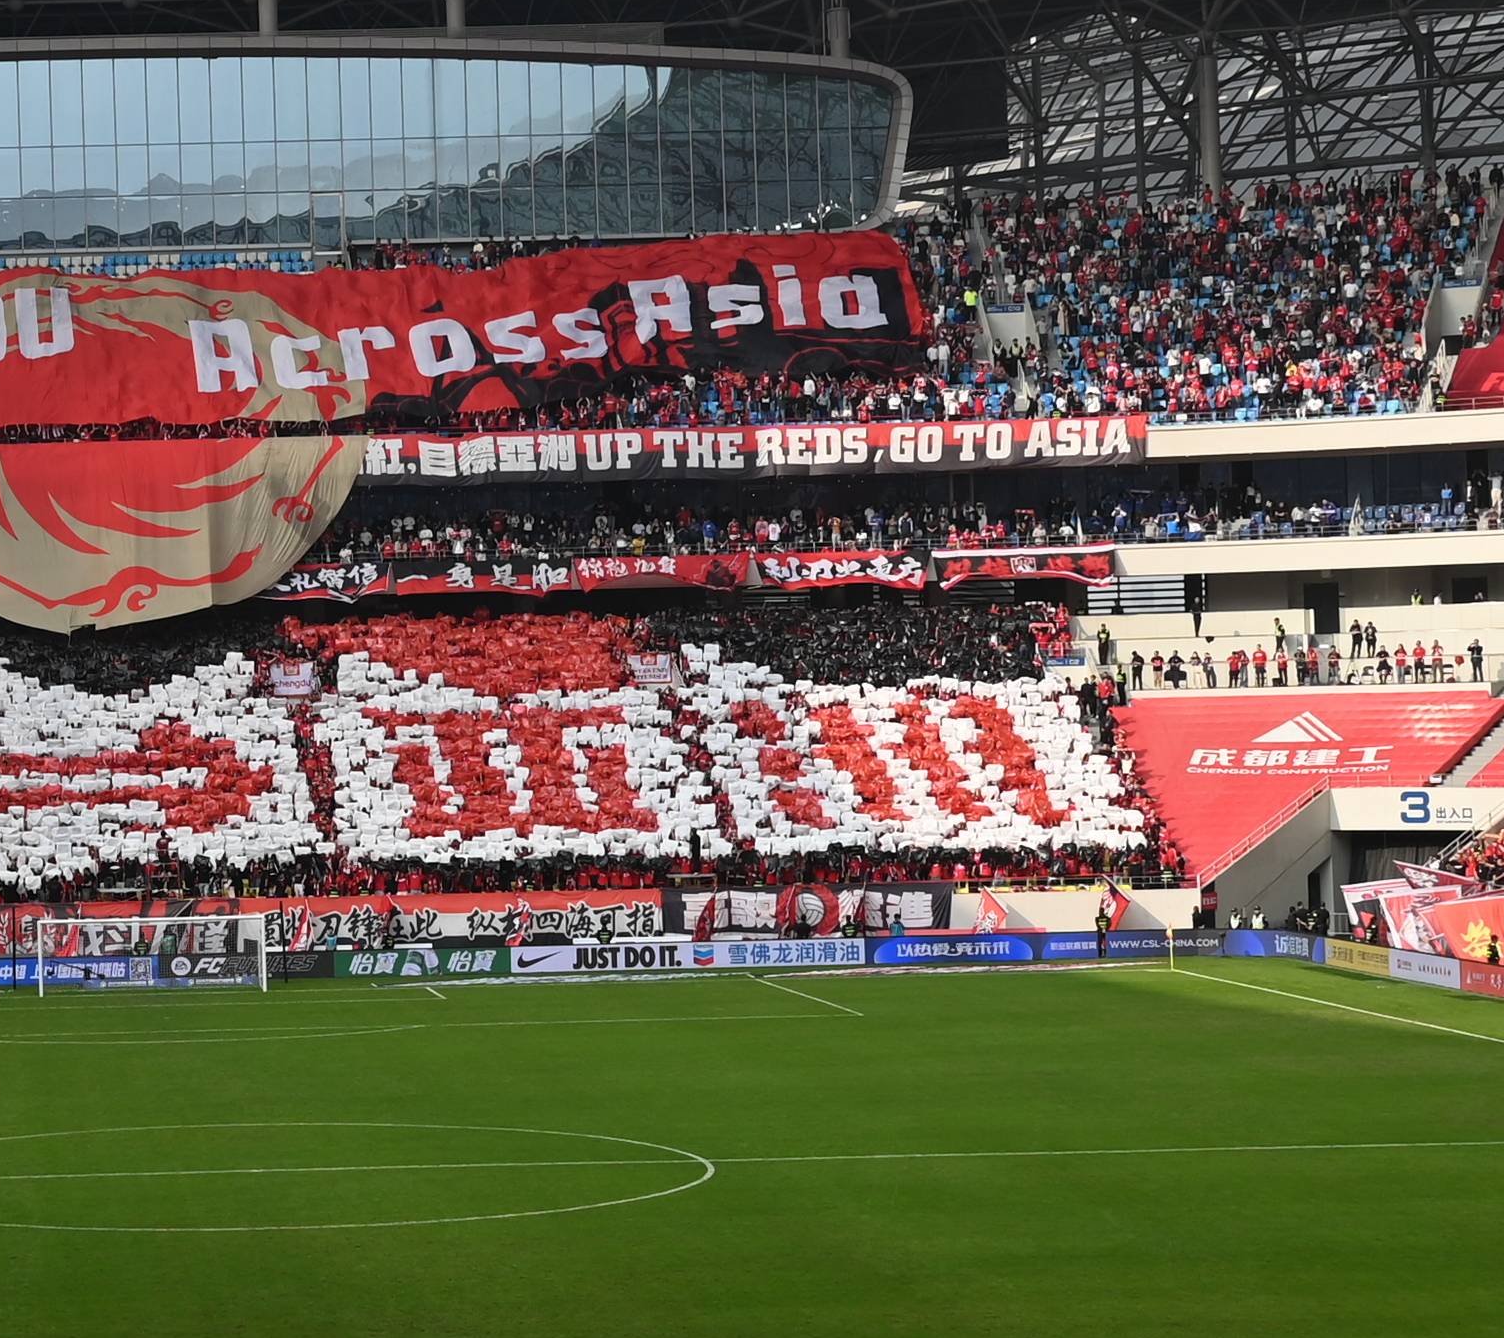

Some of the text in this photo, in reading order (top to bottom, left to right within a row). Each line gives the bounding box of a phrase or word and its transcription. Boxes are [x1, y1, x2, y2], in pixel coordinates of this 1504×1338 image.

[188, 308, 608, 394] Across
[627, 264, 889, 345] Asia
[583, 430, 643, 470] UP
[652, 430, 745, 470] THE
[952, 422, 1014, 462] TO
[1024, 418, 1132, 459] ASIA
[1188, 744, 1394, 767] 成都建工
[1186, 764, 1389, 775] CHENGDU CONSTRUCTION
[1400, 791, 1431, 824] 3
[1435, 807, 1474, 819] 出入口
[727, 940, 864, 965] 雪佛龙润滑油
[1109, 938, 1219, 949] WWW.CSL-CHINA.COM
[194, 959, 226, 974] FC
[349, 949, 497, 976] 怡寶 怡寶
[573, 945, 682, 970] JUST DO IT.
